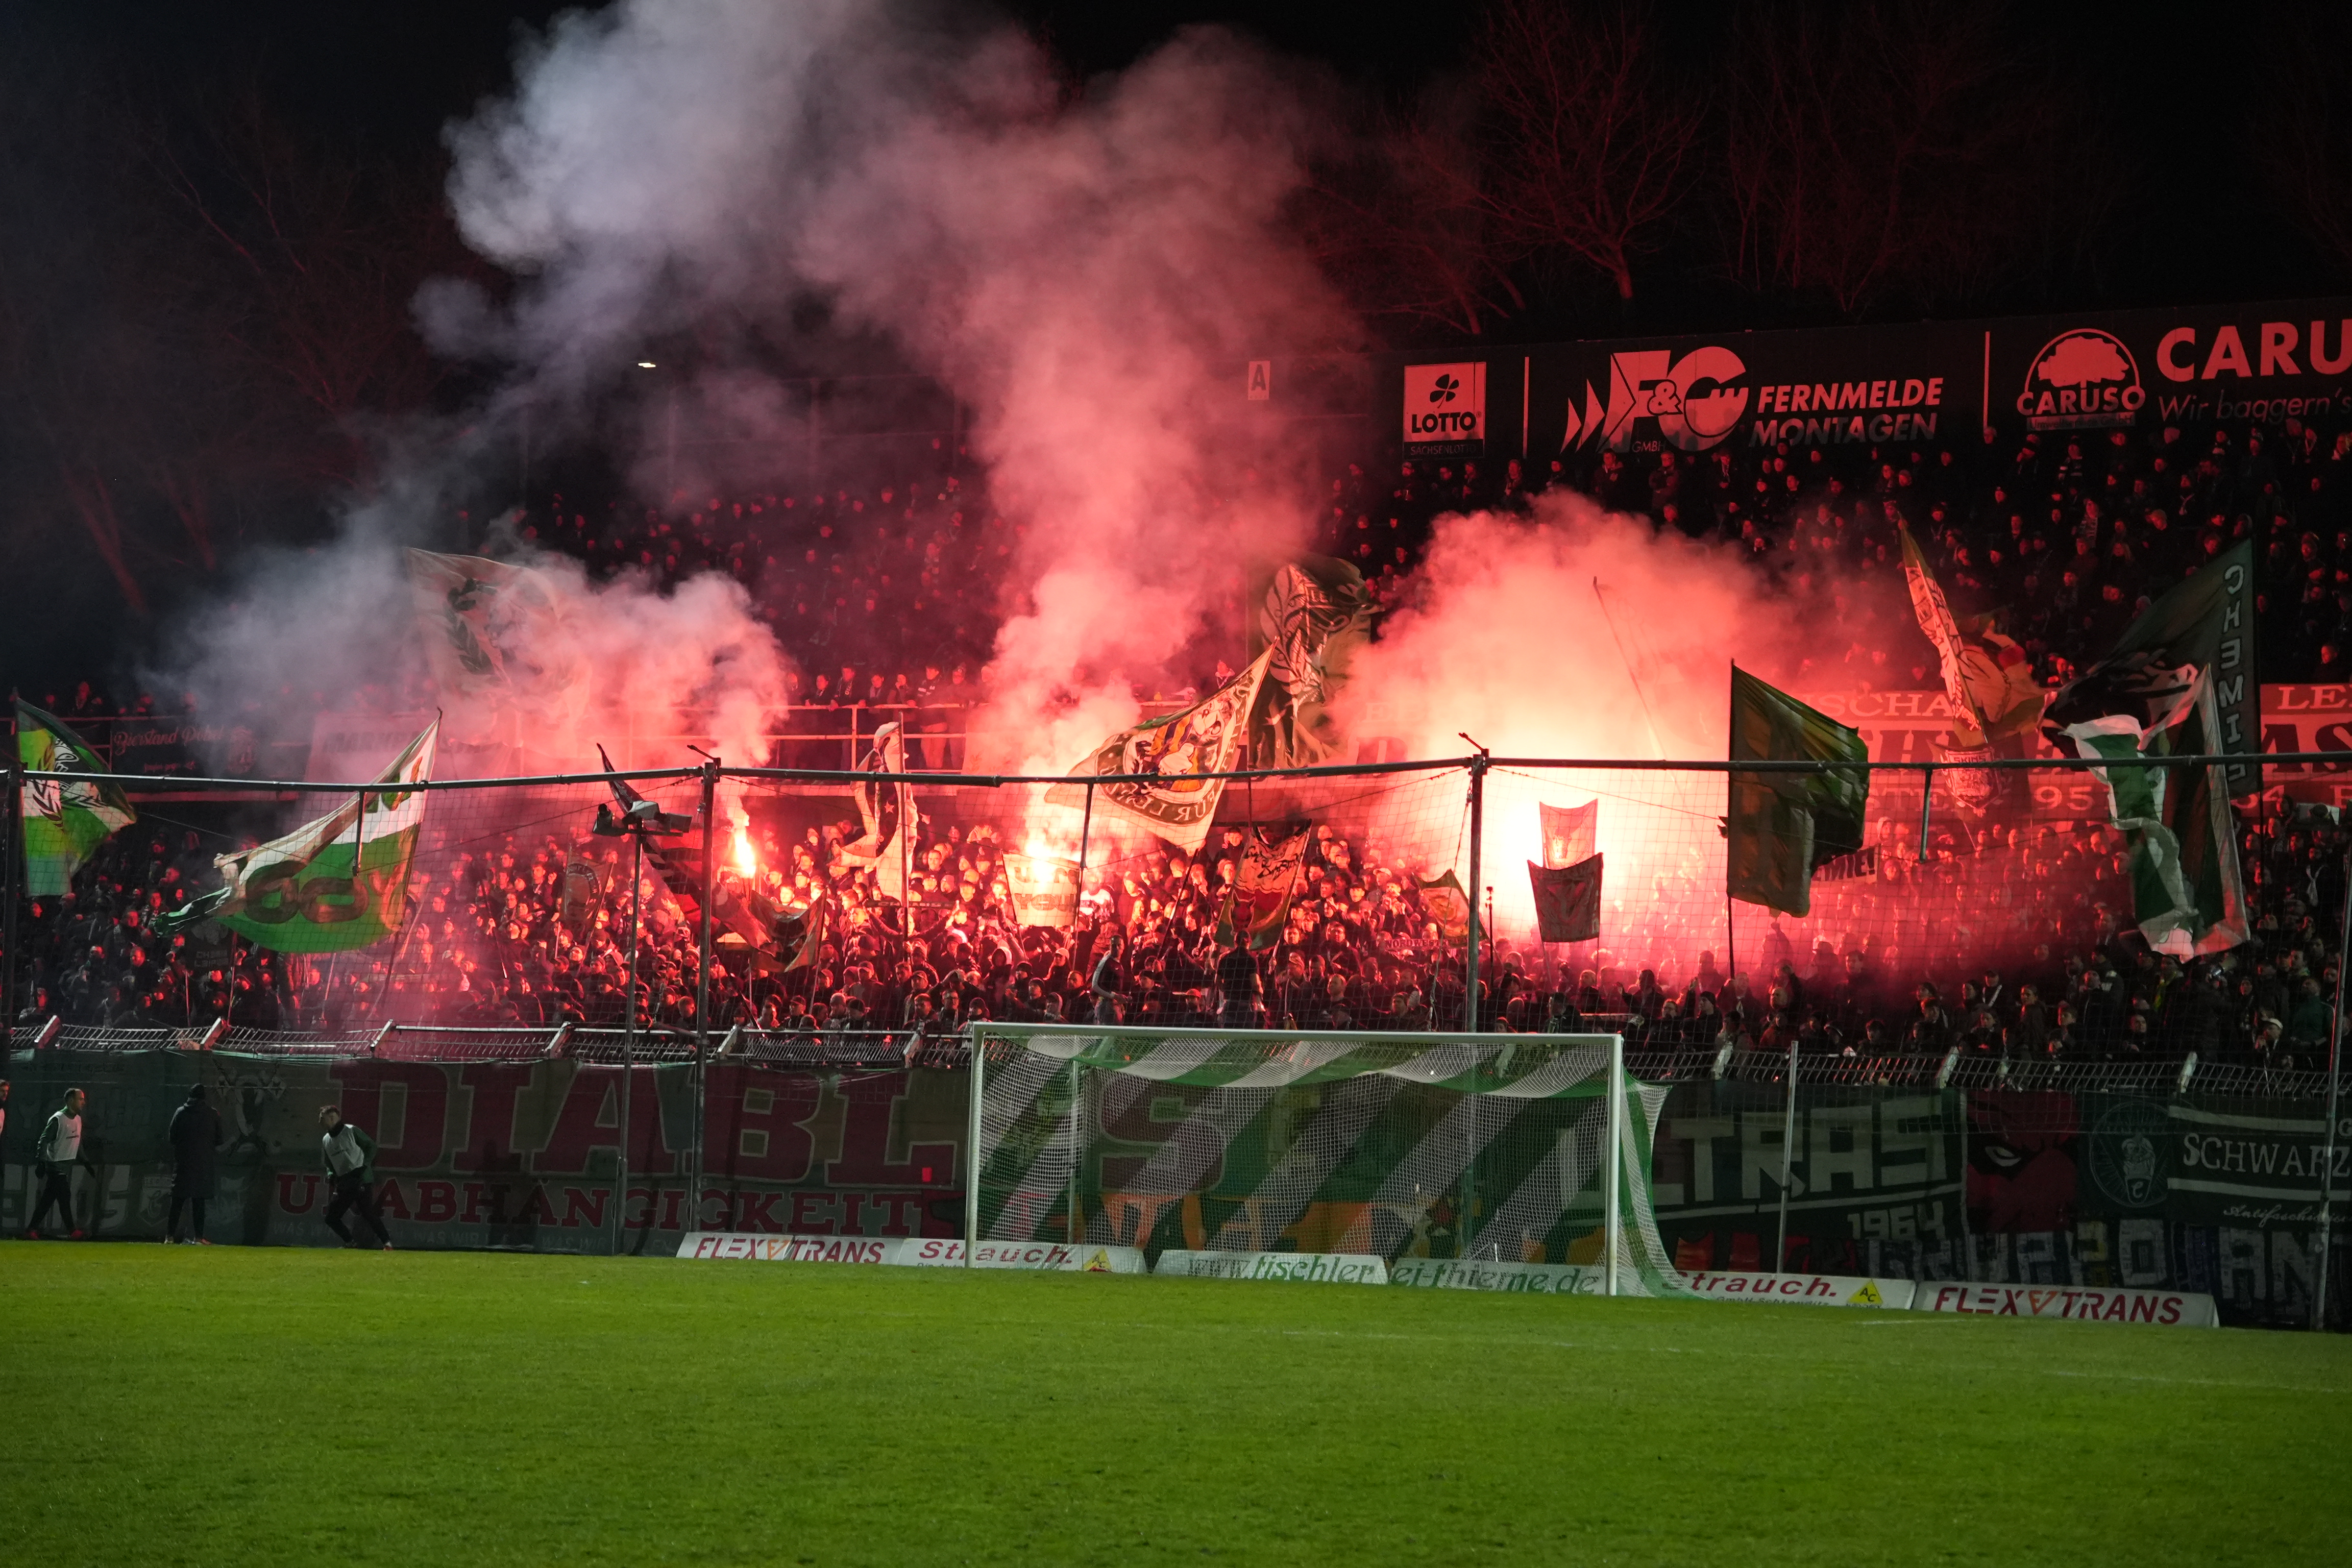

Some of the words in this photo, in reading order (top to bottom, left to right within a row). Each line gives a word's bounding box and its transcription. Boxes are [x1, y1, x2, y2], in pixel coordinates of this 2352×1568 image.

[1252, 364, 1266, 391] A
[1757, 378, 1944, 413] FERNMELDE
[2017, 385, 2146, 416] CARUSO
[2159, 394, 2209, 422] Wir
[1412, 411, 1476, 433] LOTTO
[1749, 412, 1938, 447] MONTAGEN
[1847, 1200, 1947, 1241] 1964
[2061, 1291, 2184, 1325] TRANS
